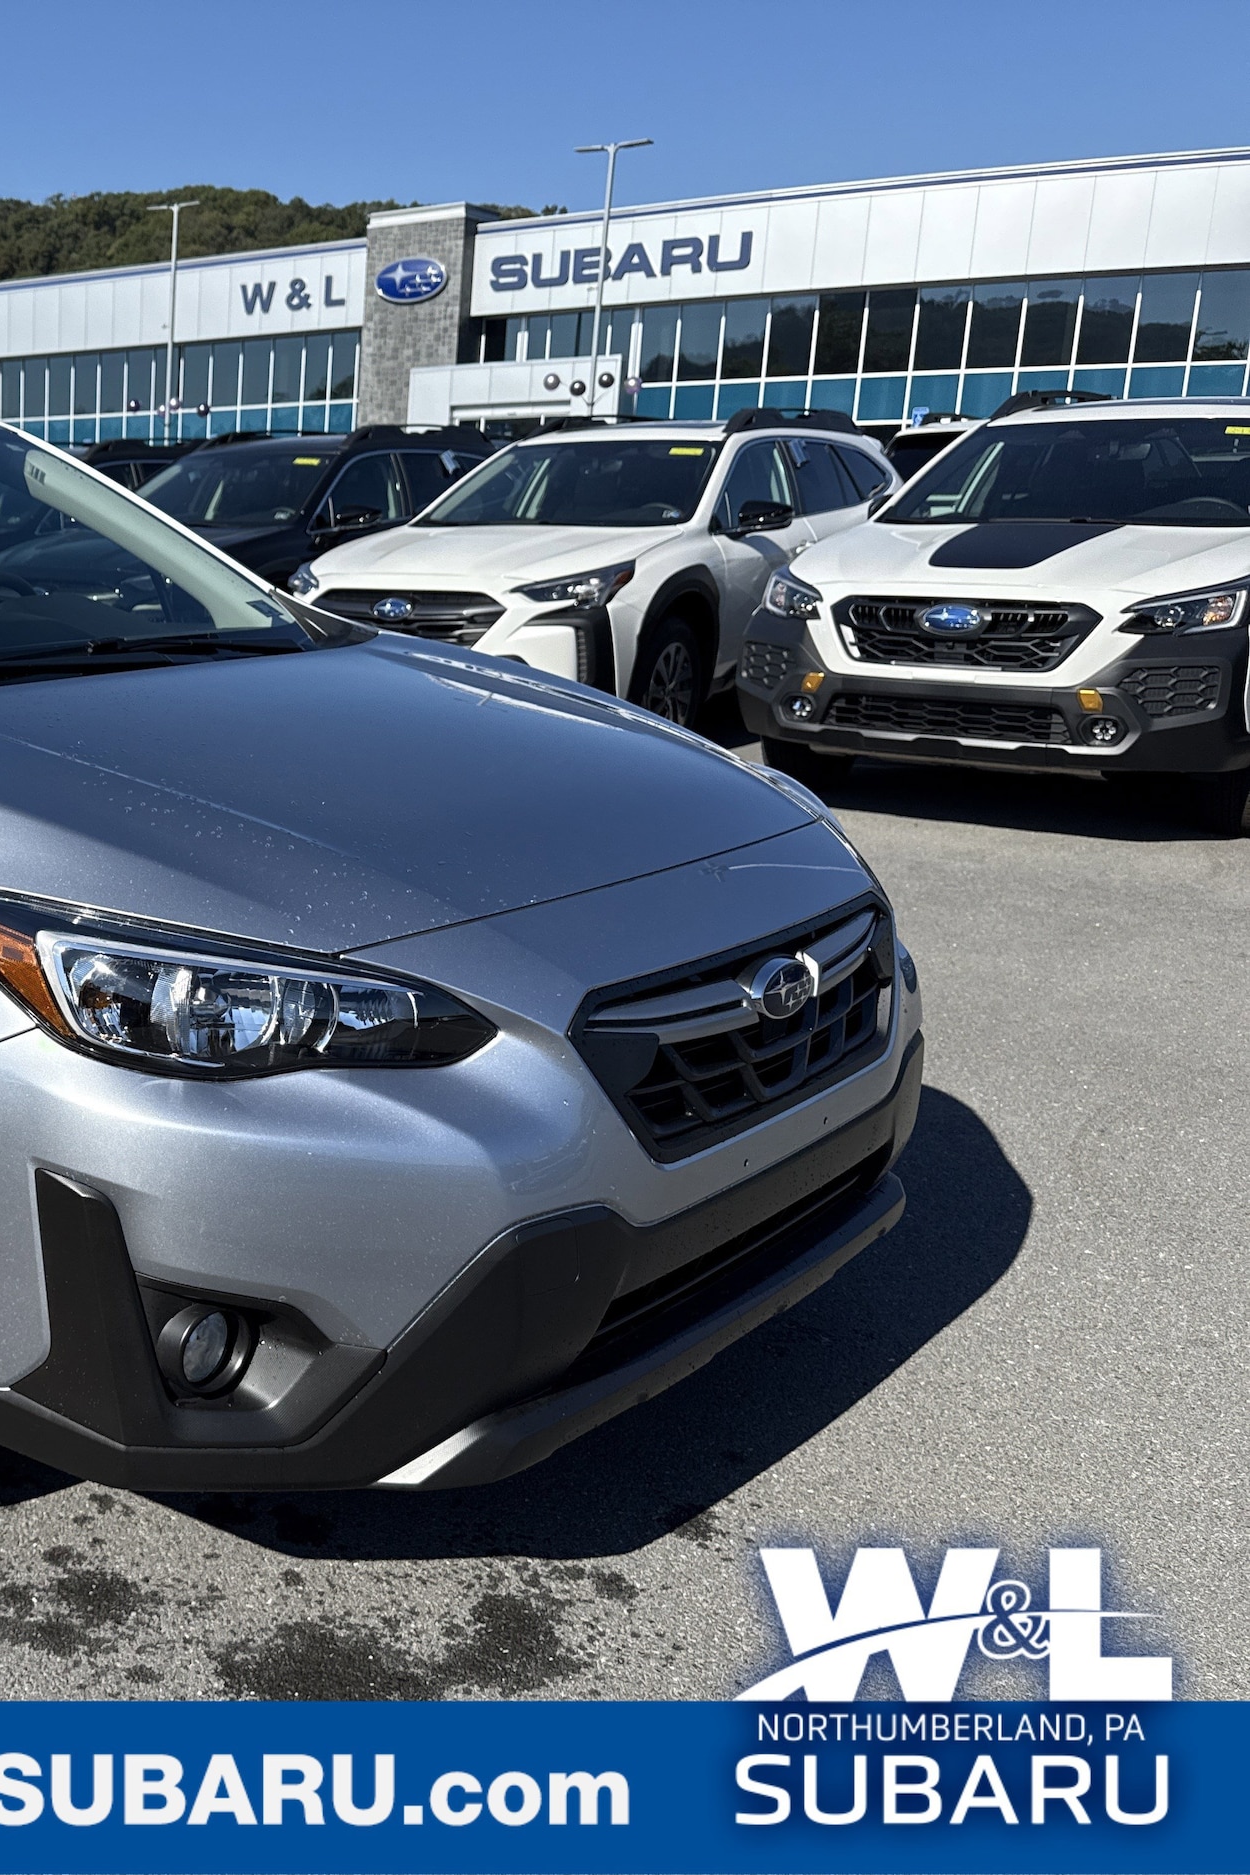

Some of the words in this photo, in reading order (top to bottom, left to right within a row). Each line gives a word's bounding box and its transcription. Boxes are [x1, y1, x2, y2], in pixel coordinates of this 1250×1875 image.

[490, 230, 754, 292] SUBARU
[241, 281, 276, 315] W
[285, 278, 312, 311] &
[323, 275, 346, 307] L
